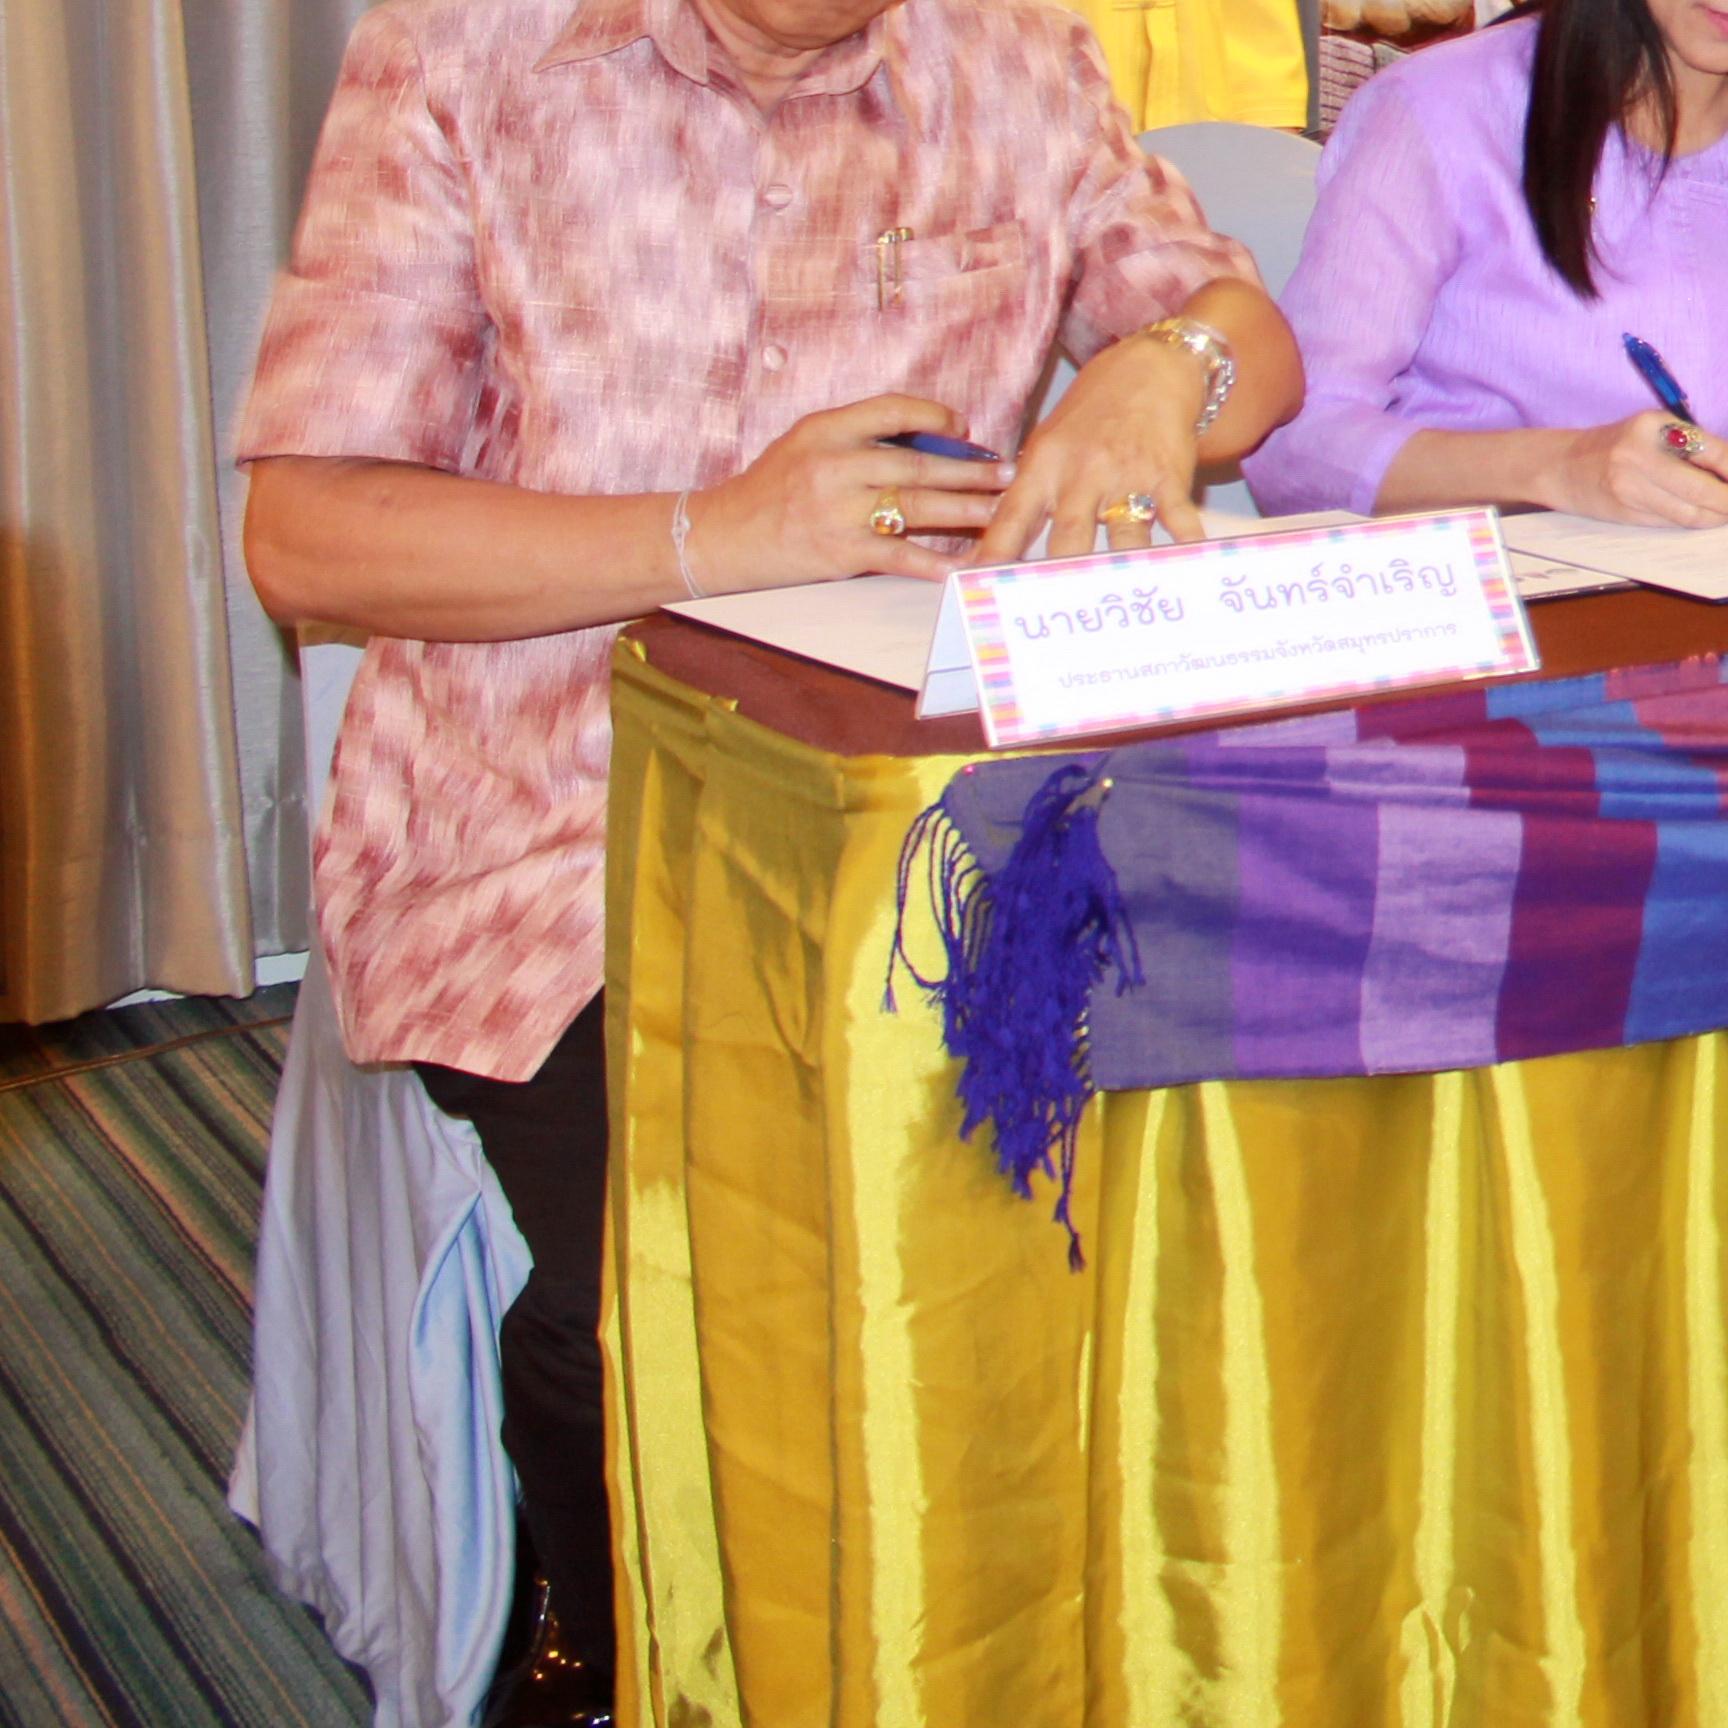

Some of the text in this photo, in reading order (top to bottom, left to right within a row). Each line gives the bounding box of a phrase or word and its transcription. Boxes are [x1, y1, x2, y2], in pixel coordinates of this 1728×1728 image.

[1014, 555, 1461, 642] นายวิชัย จันทร์จำเริญ
[1057, 619, 1460, 691] ประธานสภาวัฒนธรรมจังหวัดสมุทรปราการ
